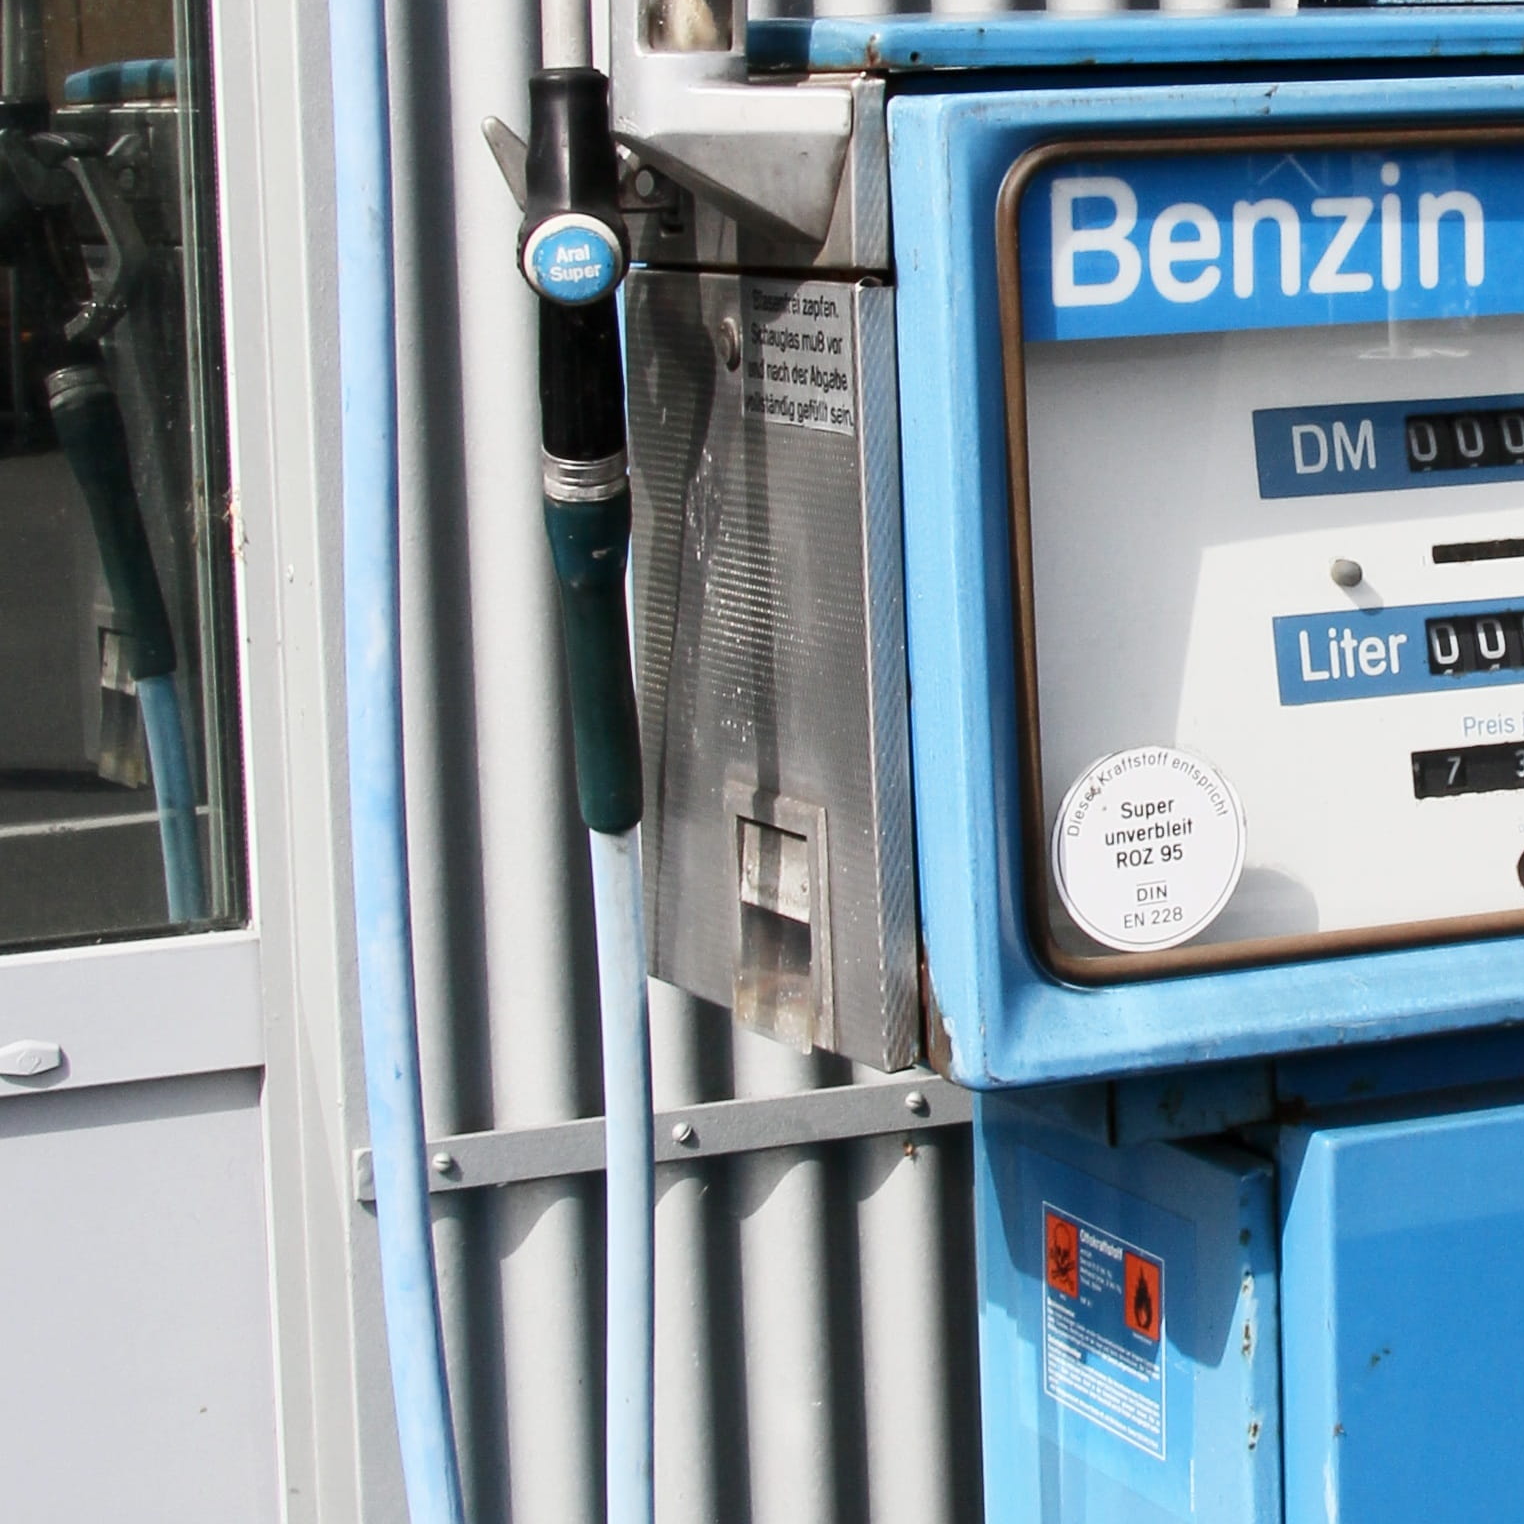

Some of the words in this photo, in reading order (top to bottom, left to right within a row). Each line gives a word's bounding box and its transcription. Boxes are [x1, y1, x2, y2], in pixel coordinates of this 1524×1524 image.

[1051, 162, 1485, 307] Benzin
[556, 244, 590, 263] Aral
[550, 264, 601, 282] Super
[828, 336, 843, 355] vor
[792, 363, 808, 384] der
[810, 365, 848, 393] Abgabe
[1292, 419, 1376, 474] DM
[1299, 627, 1407, 681] Liter
[1463, 713, 1515, 737] Preis
[1097, 752, 1169, 786] Kraftstoff
[1172, 758, 1229, 817] entspricht
[1121, 799, 1174, 819] Super
[1105, 818, 1192, 846] unverbleit
[1117, 848, 1154, 868] ROZ
[1161, 844, 1183, 862] 95
[1137, 885, 1168, 902] DIN
[1124, 914, 1144, 929] EN
[1151, 906, 1183, 925] 228
